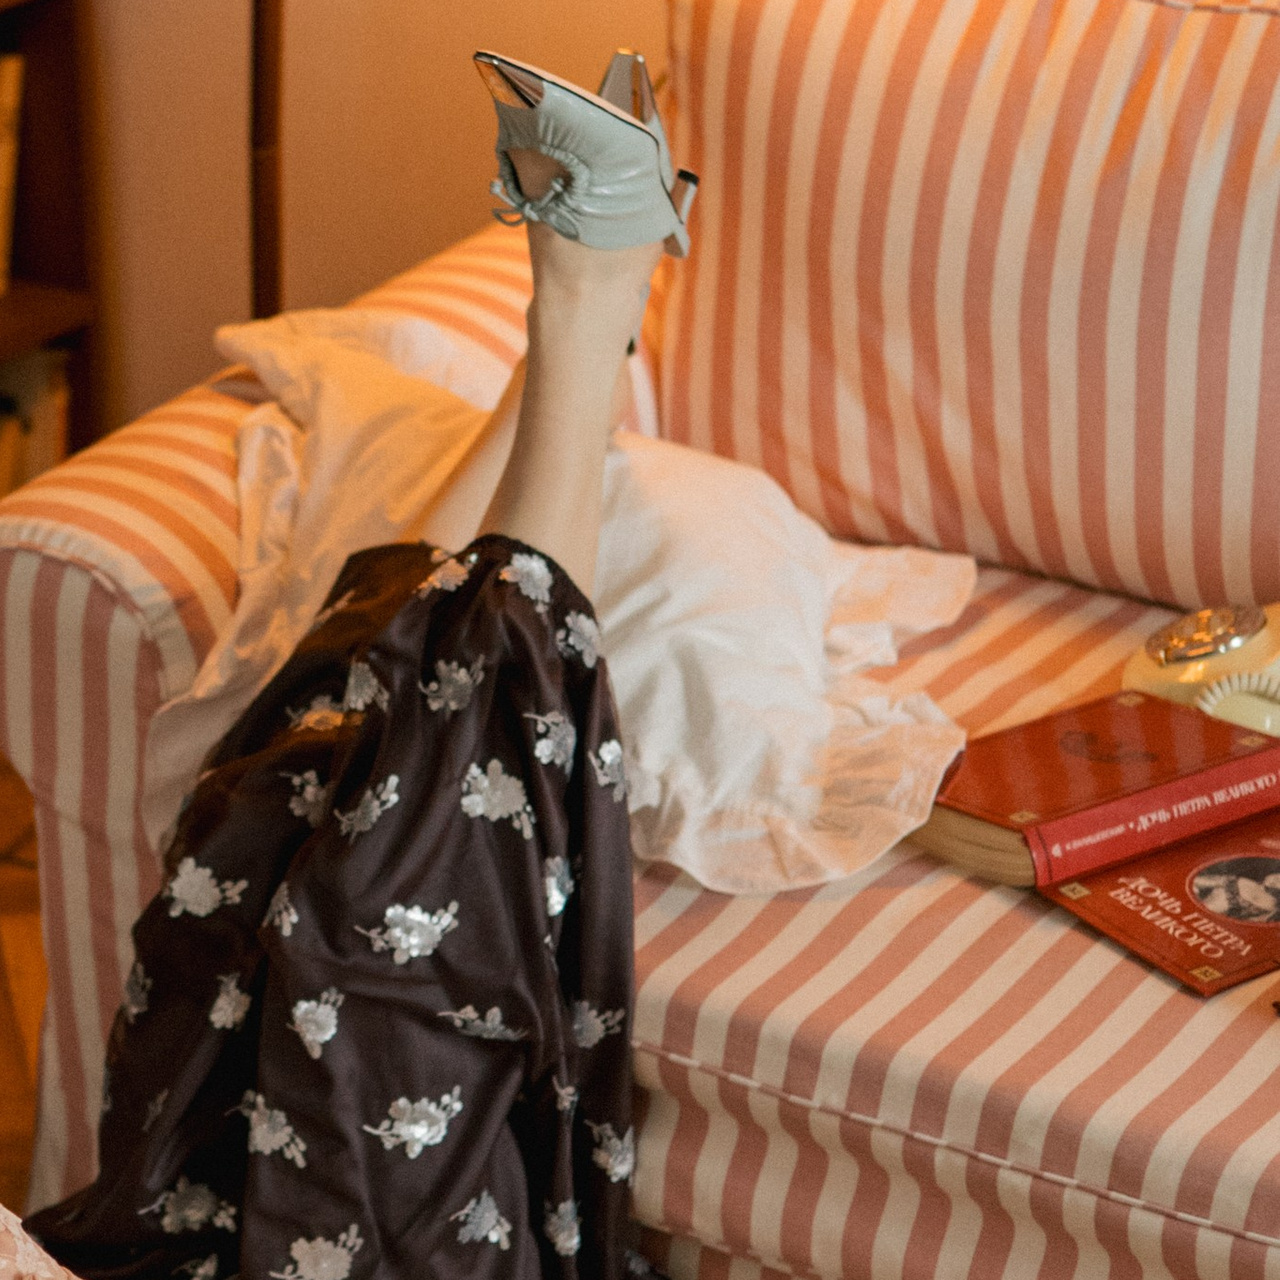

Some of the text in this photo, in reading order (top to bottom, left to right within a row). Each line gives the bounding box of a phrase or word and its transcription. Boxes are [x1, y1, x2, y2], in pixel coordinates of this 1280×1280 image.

[1137, 773, 1277, 832] ДОЧЬ ПЕТРА ВЕЛИКОГО
[1108, 887, 1224, 958] ВЕЛИКОГО
[1118, 877, 1252, 956] ДОЧЬ ПЕТРА
